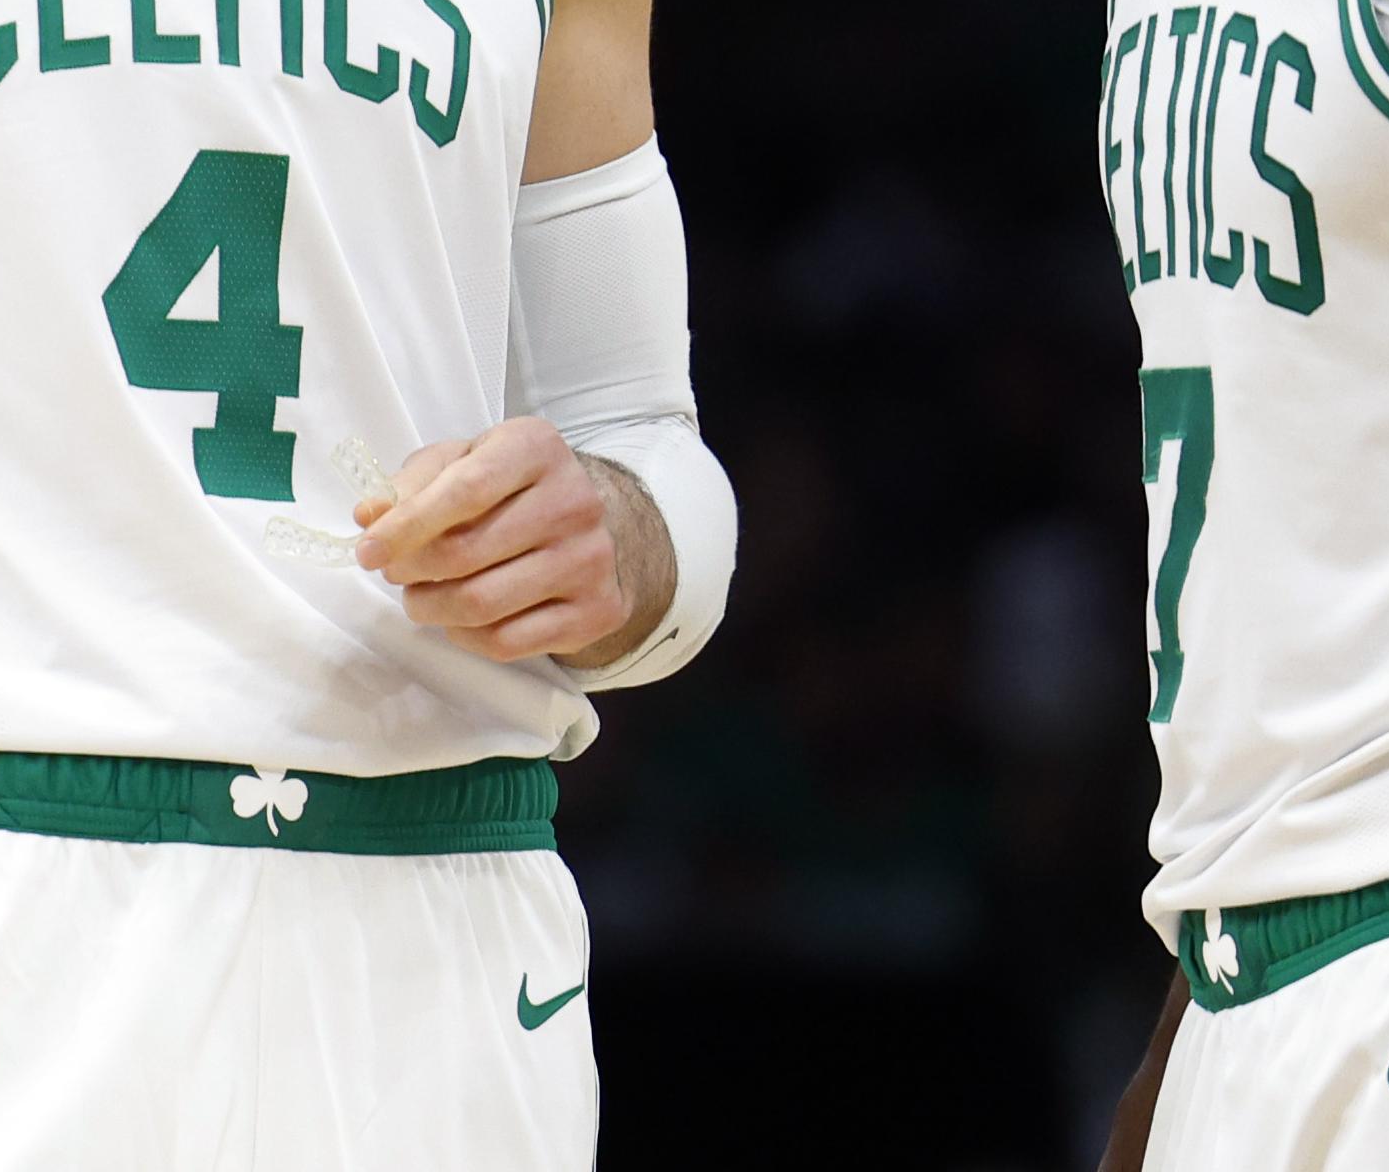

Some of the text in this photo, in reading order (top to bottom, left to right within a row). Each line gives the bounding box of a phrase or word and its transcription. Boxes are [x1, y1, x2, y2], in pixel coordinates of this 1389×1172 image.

[101, 149, 304, 502] 4
[1100, 5, 1325, 316] ELTICS
[1138, 366, 1215, 723] 7
